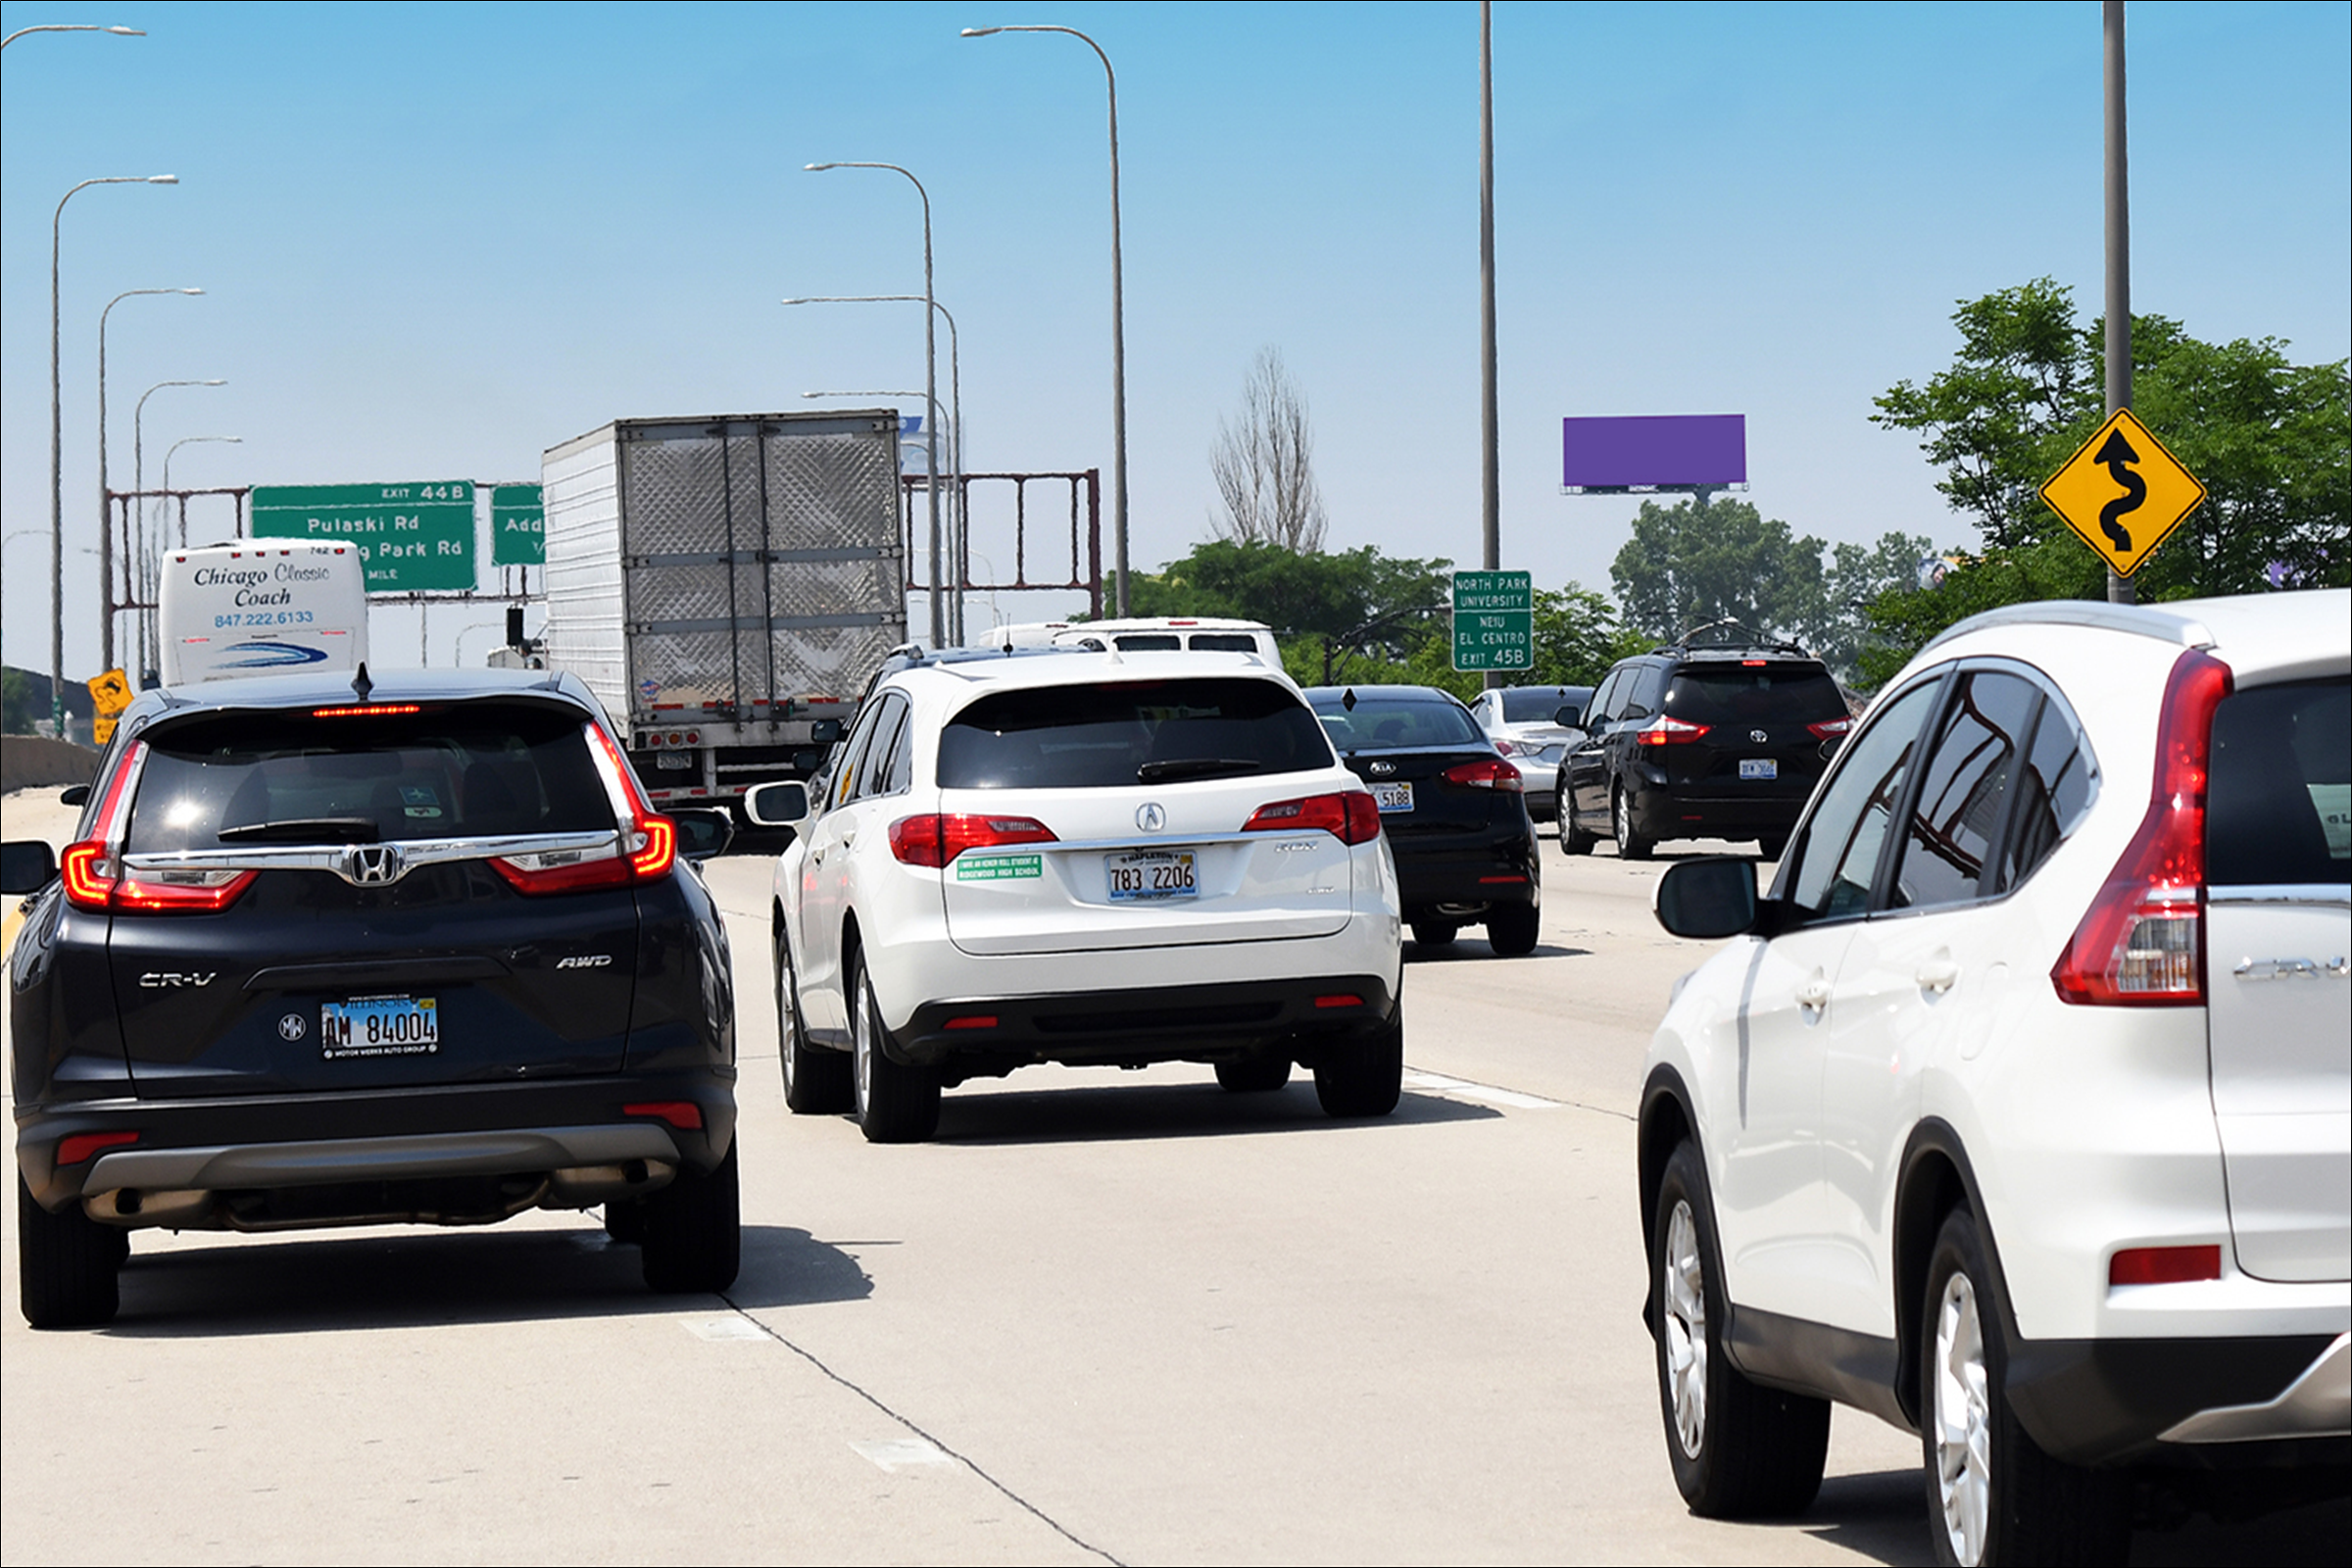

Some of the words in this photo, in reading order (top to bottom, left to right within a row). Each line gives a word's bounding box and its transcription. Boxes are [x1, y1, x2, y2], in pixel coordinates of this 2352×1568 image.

[381, 488, 410, 499] EXIT
[307, 516, 385, 533] Pulaski
[394, 515, 419, 530] Rd
[379, 542, 426, 558] Park
[437, 540, 463, 556] Rd
[194, 567, 269, 587] Chicago
[274, 563, 330, 582] Classic
[368, 569, 398, 580] MILE
[1455, 578, 1492, 591] NORTH
[1497, 577, 1528, 590] PARK
[234, 588, 291, 607] Coach
[1460, 594, 1523, 608] UNIVERSITY
[215, 611, 314, 628] 847.222.6133
[1479, 616, 1505, 628] NEIU
[1459, 632, 1474, 645] EL
[1481, 631, 1525, 645] CENTRO
[1461, 653, 1486, 665] EXIT
[1494, 649, 1524, 664] 45B
[1382, 791, 1409, 807] 5188
[959, 868, 996, 878] RIDGEWOOD
[998, 867, 1013, 876] HIGH
[1014, 866, 1039, 876] SCHOOL
[1110, 868, 1142, 892] 783
[1152, 864, 1195, 890] 2206
[556, 955, 612, 969] AWD
[139, 972, 217, 987] CR-V
[325, 1015, 352, 1047] AM
[367, 1011, 436, 1044] 84004
[335, 1048, 359, 1057] MOTOR
[360, 1047, 382, 1056] WERKS
[384, 1046, 401, 1055] AUTO
[403, 1045, 426, 1054] GROUP
